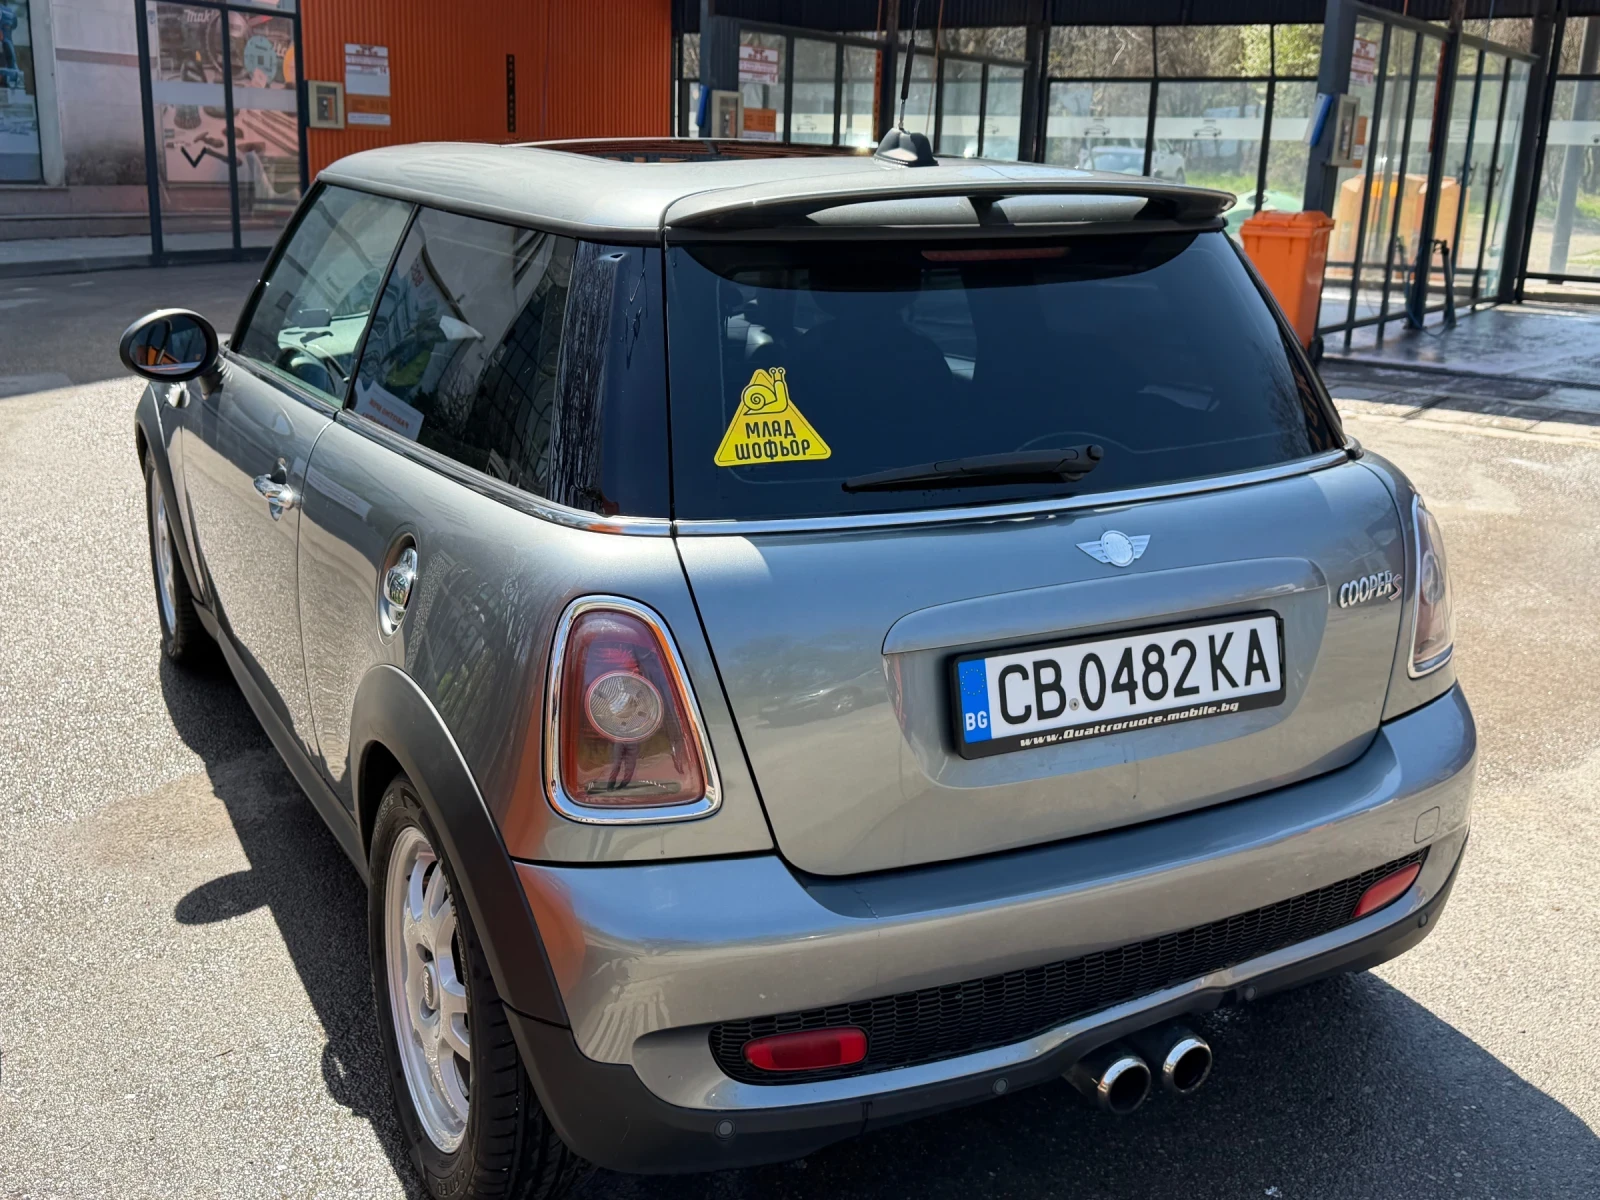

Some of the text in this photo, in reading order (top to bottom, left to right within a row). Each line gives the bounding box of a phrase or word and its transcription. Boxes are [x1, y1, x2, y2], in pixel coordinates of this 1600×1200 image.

[745, 419, 797, 439] МЛАД
[734, 438, 811, 460] ШОФЬОР
[1339, 569, 1402, 609] COOPER S
[998, 628, 1271, 725] CB 0482 KA
[965, 710, 988, 732] BG
[1019, 701, 1239, 748] www.Quattroruote.mobile.bg
